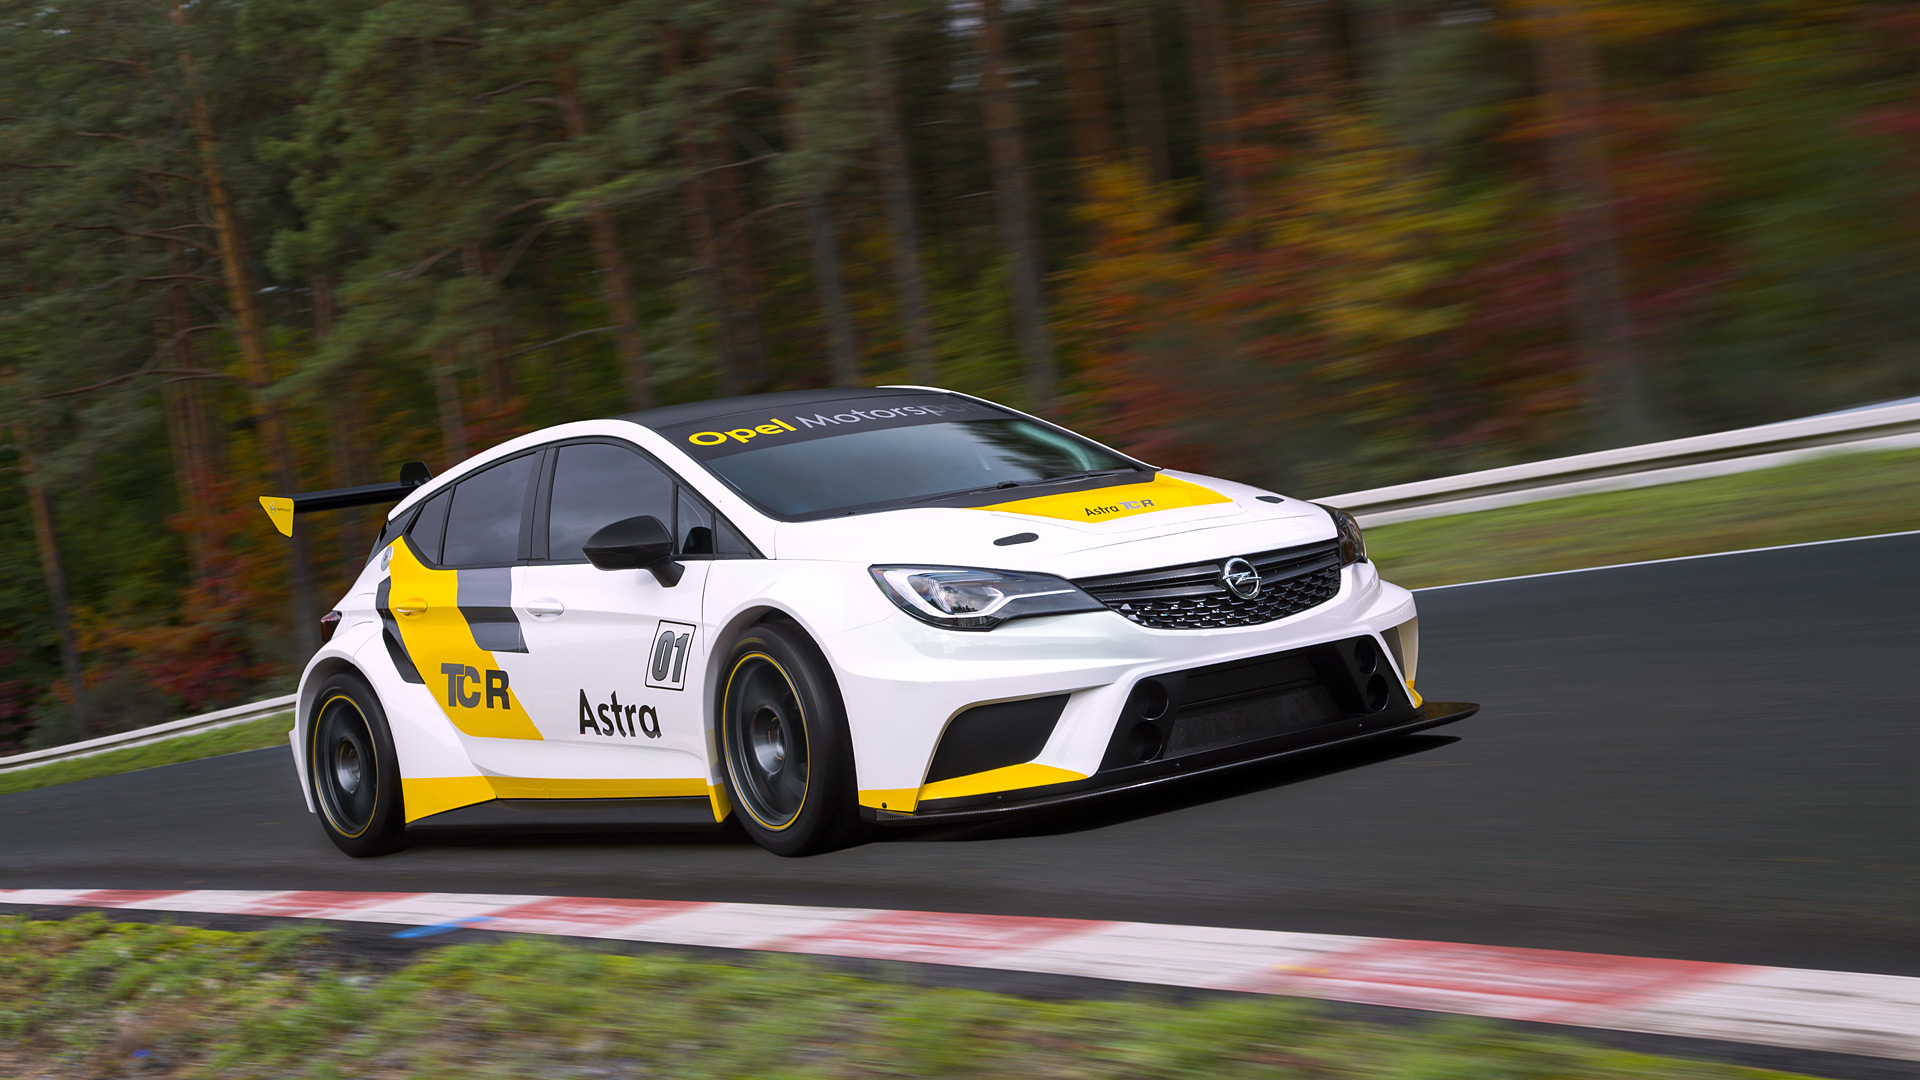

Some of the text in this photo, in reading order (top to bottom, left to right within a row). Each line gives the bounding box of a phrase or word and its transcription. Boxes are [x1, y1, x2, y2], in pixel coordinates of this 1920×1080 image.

[688, 418, 797, 446] Opel
[1084, 505, 1120, 517] Astra
[651, 630, 690, 683] 01
[441, 662, 511, 710] TCR
[579, 688, 662, 739] Astra
